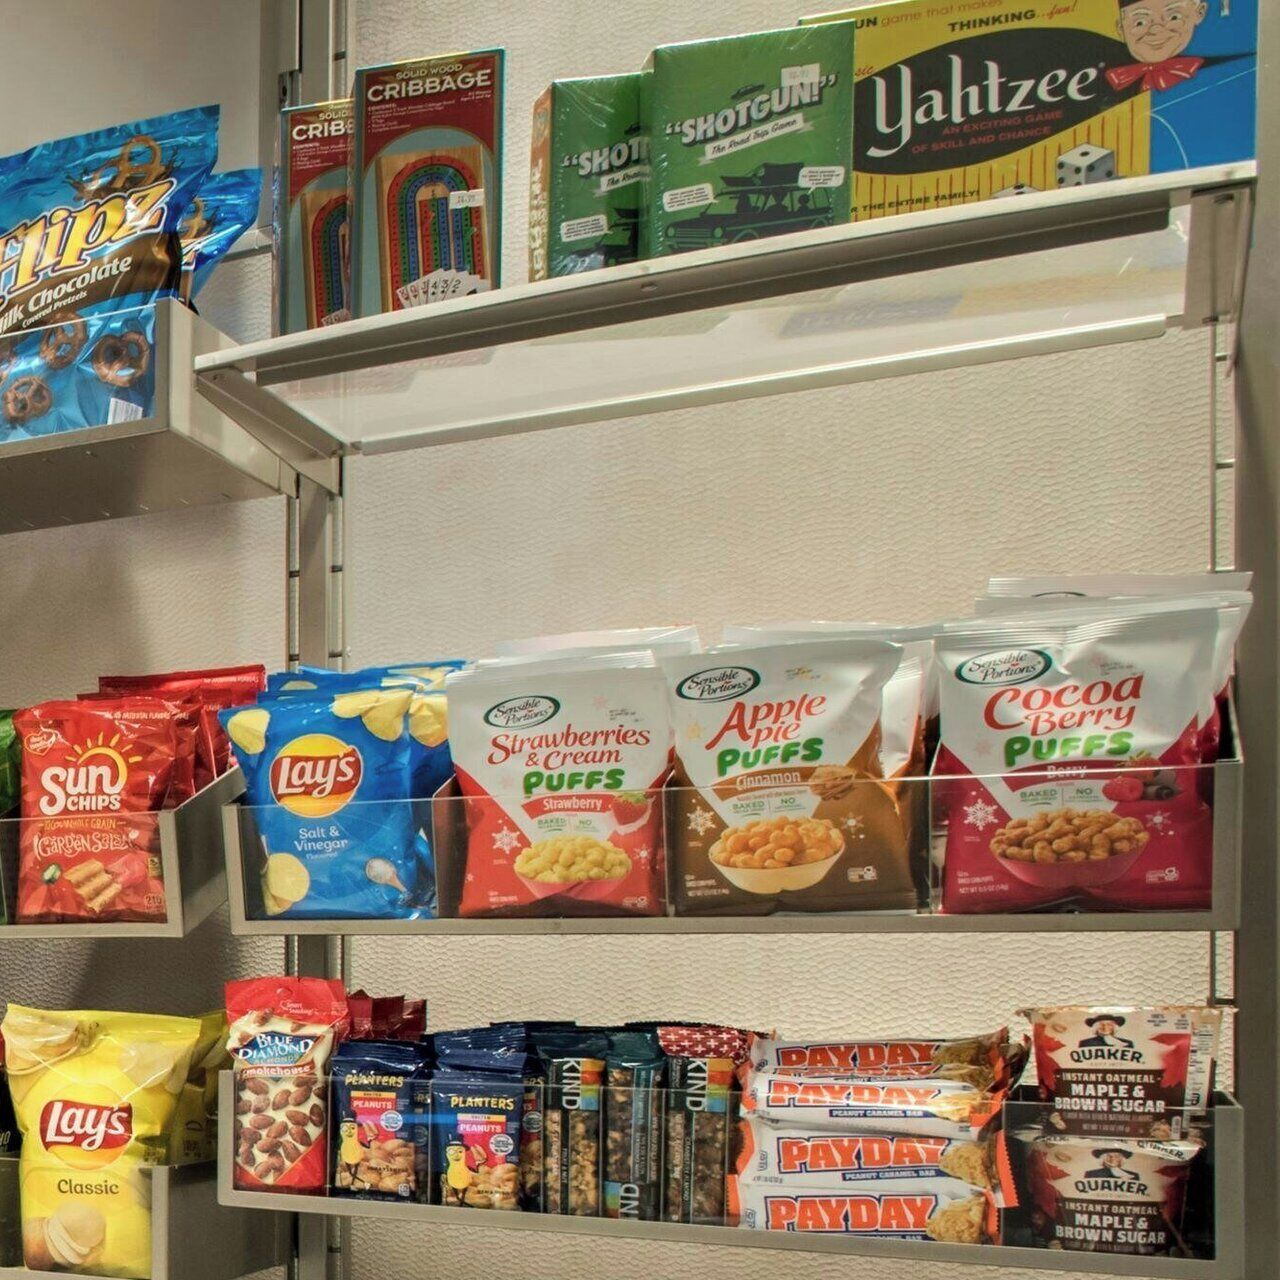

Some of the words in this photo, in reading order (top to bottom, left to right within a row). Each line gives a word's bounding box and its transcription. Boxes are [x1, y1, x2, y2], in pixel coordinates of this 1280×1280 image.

[396, 68, 427, 80] SOLID
[430, 63, 463, 75] WOOD
[367, 69, 492, 102] CRIBBAGE
[866, 54, 1100, 158] Yahtzee
[943, 126, 961, 136] AN
[964, 117, 1022, 132] EXCITING
[1024, 110, 1063, 123] GAME
[912, 143, 929, 154] OF
[931, 140, 965, 151] SKILL
[969, 135, 996, 146] AND
[998, 126, 1052, 143] CHANCE
[29, 255, 133, 312] Chocolate
[984, 674, 1144, 731] Cocoa
[705, 693, 827, 751] Apple
[1024, 703, 1137, 737] Berry
[487, 723, 652, 765] Strawberries
[752, 720, 801, 750] pie
[525, 754, 541, 768] &
[543, 749, 623, 772] Cream
[717, 737, 825, 777] PUFFS
[1004, 731, 1136, 768] PUFFS
[277, 750, 357, 799] Lay's
[523, 768, 627, 796] PUFFS
[736, 771, 802, 791] Cinnamon
[39, 764, 128, 816] Sun
[66, 795, 122, 812] CHIPS
[543, 797, 604, 812] Strawberry
[299, 826, 326, 840] Salt
[329, 825, 341, 838] &
[293, 838, 350, 853] Vinegar
[239, 1038, 315, 1060] DIAMOND
[256, 1033, 294, 1049] BLUE
[778, 1042, 940, 1069] PAYDAY
[1070, 1047, 1143, 1064] QUAKER
[562, 1057, 582, 1110] KIND
[686, 1057, 708, 1112] KIND
[1062, 1072, 1102, 1082] INSTANT
[1106, 1073, 1155, 1083] OATMEAL
[450, 1095, 515, 1110] PLANTERS
[768, 1081, 941, 1107] PAYDAY
[1071, 1083, 1129, 1097] MAPLE
[1132, 1084, 1145, 1098] &
[353, 1099, 392, 1110] PEANUTS
[832, 1109, 863, 1118] PEANUT
[865, 1109, 904, 1118] CARAMEL
[906, 1109, 923, 1118] BAR
[1055, 1097, 1109, 1111] BROWN
[1112, 1099, 1165, 1113] SUGAR
[45, 1101, 129, 1151] Lay's
[460, 1122, 502, 1134] PEANUTS
[778, 1136, 951, 1173] PAYDAY
[57, 1179, 120, 1196] Classic
[1075, 1179, 1148, 1196] QUAKER
[766, 1195, 937, 1232] PAYDAY
[1065, 1202, 1108, 1213] INSTANT
[1112, 1204, 1158, 1216] OATMEAL
[1075, 1212, 1133, 1229] MAPLE
[1137, 1215, 1148, 1230] &
[1056, 1225, 1113, 1242] BROWN
[1117, 1230, 1167, 1245] SUGAR
